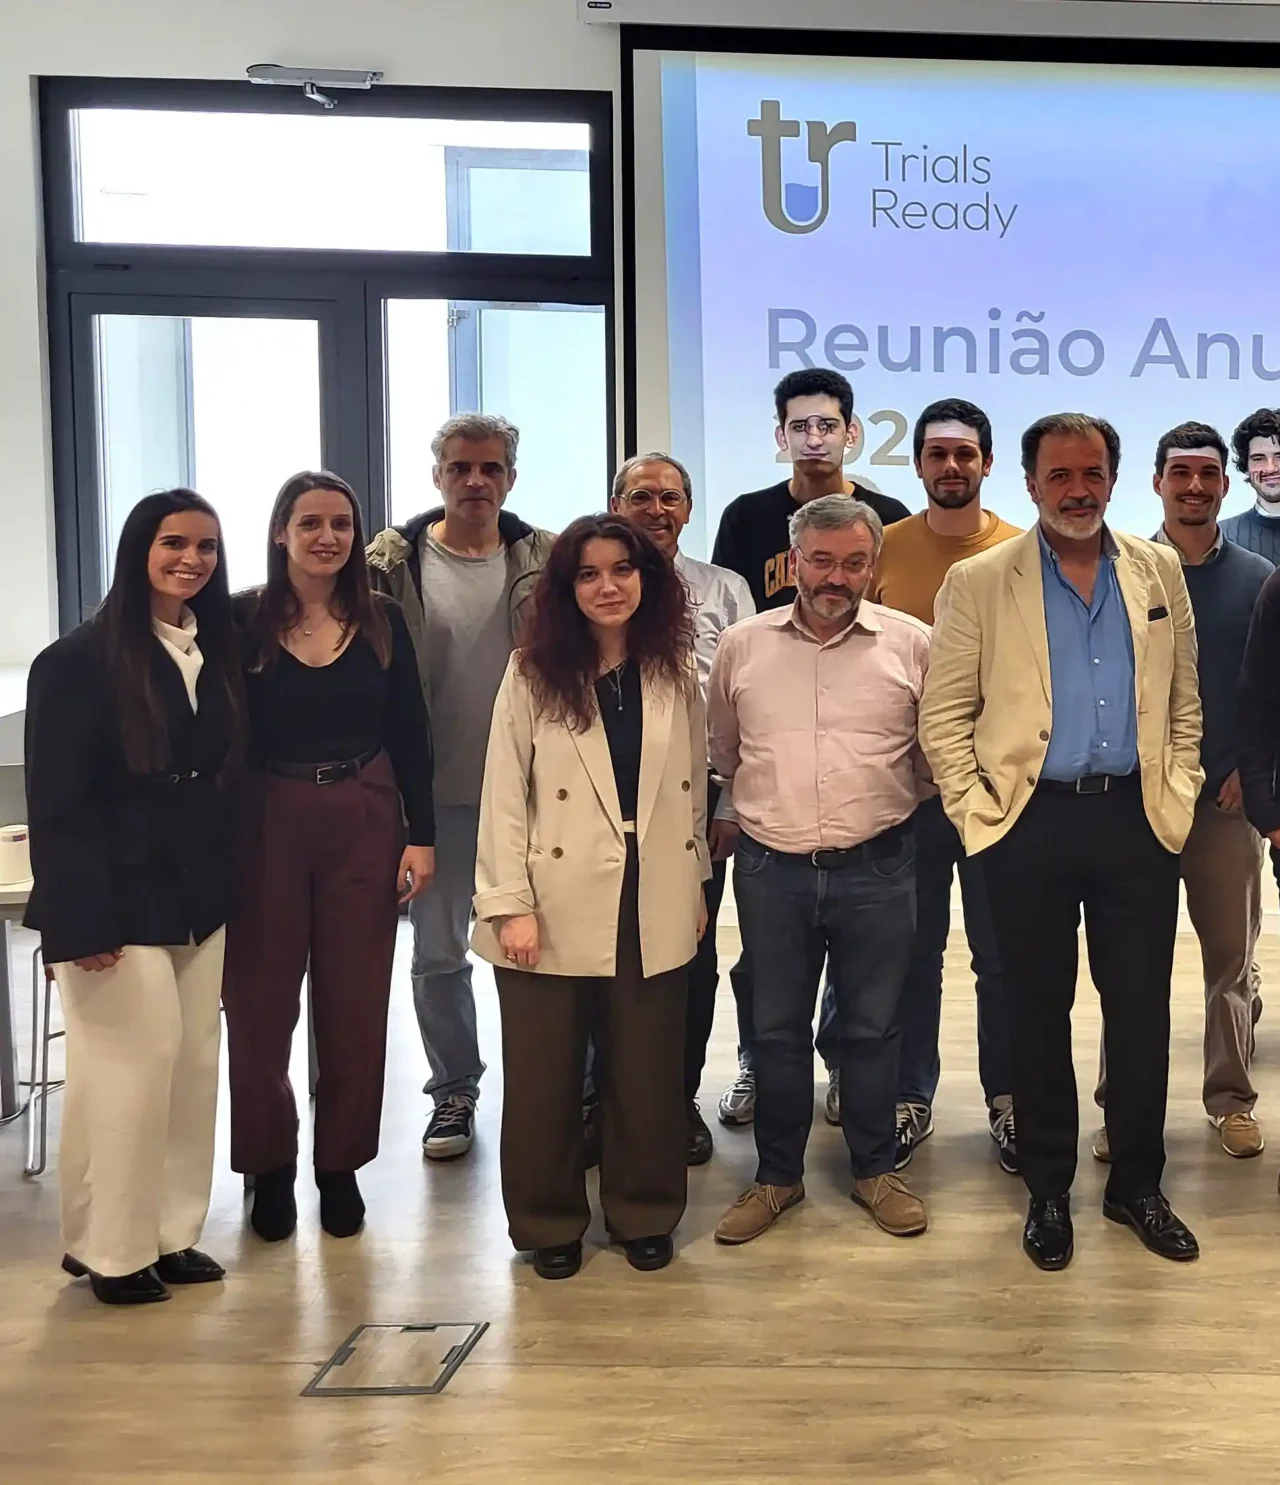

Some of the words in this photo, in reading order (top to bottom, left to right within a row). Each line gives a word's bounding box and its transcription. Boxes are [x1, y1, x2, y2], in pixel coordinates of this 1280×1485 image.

[871, 141, 991, 184] Trials
[871, 188, 1018, 238] Ready
[767, 308, 1105, 377] Reunião
